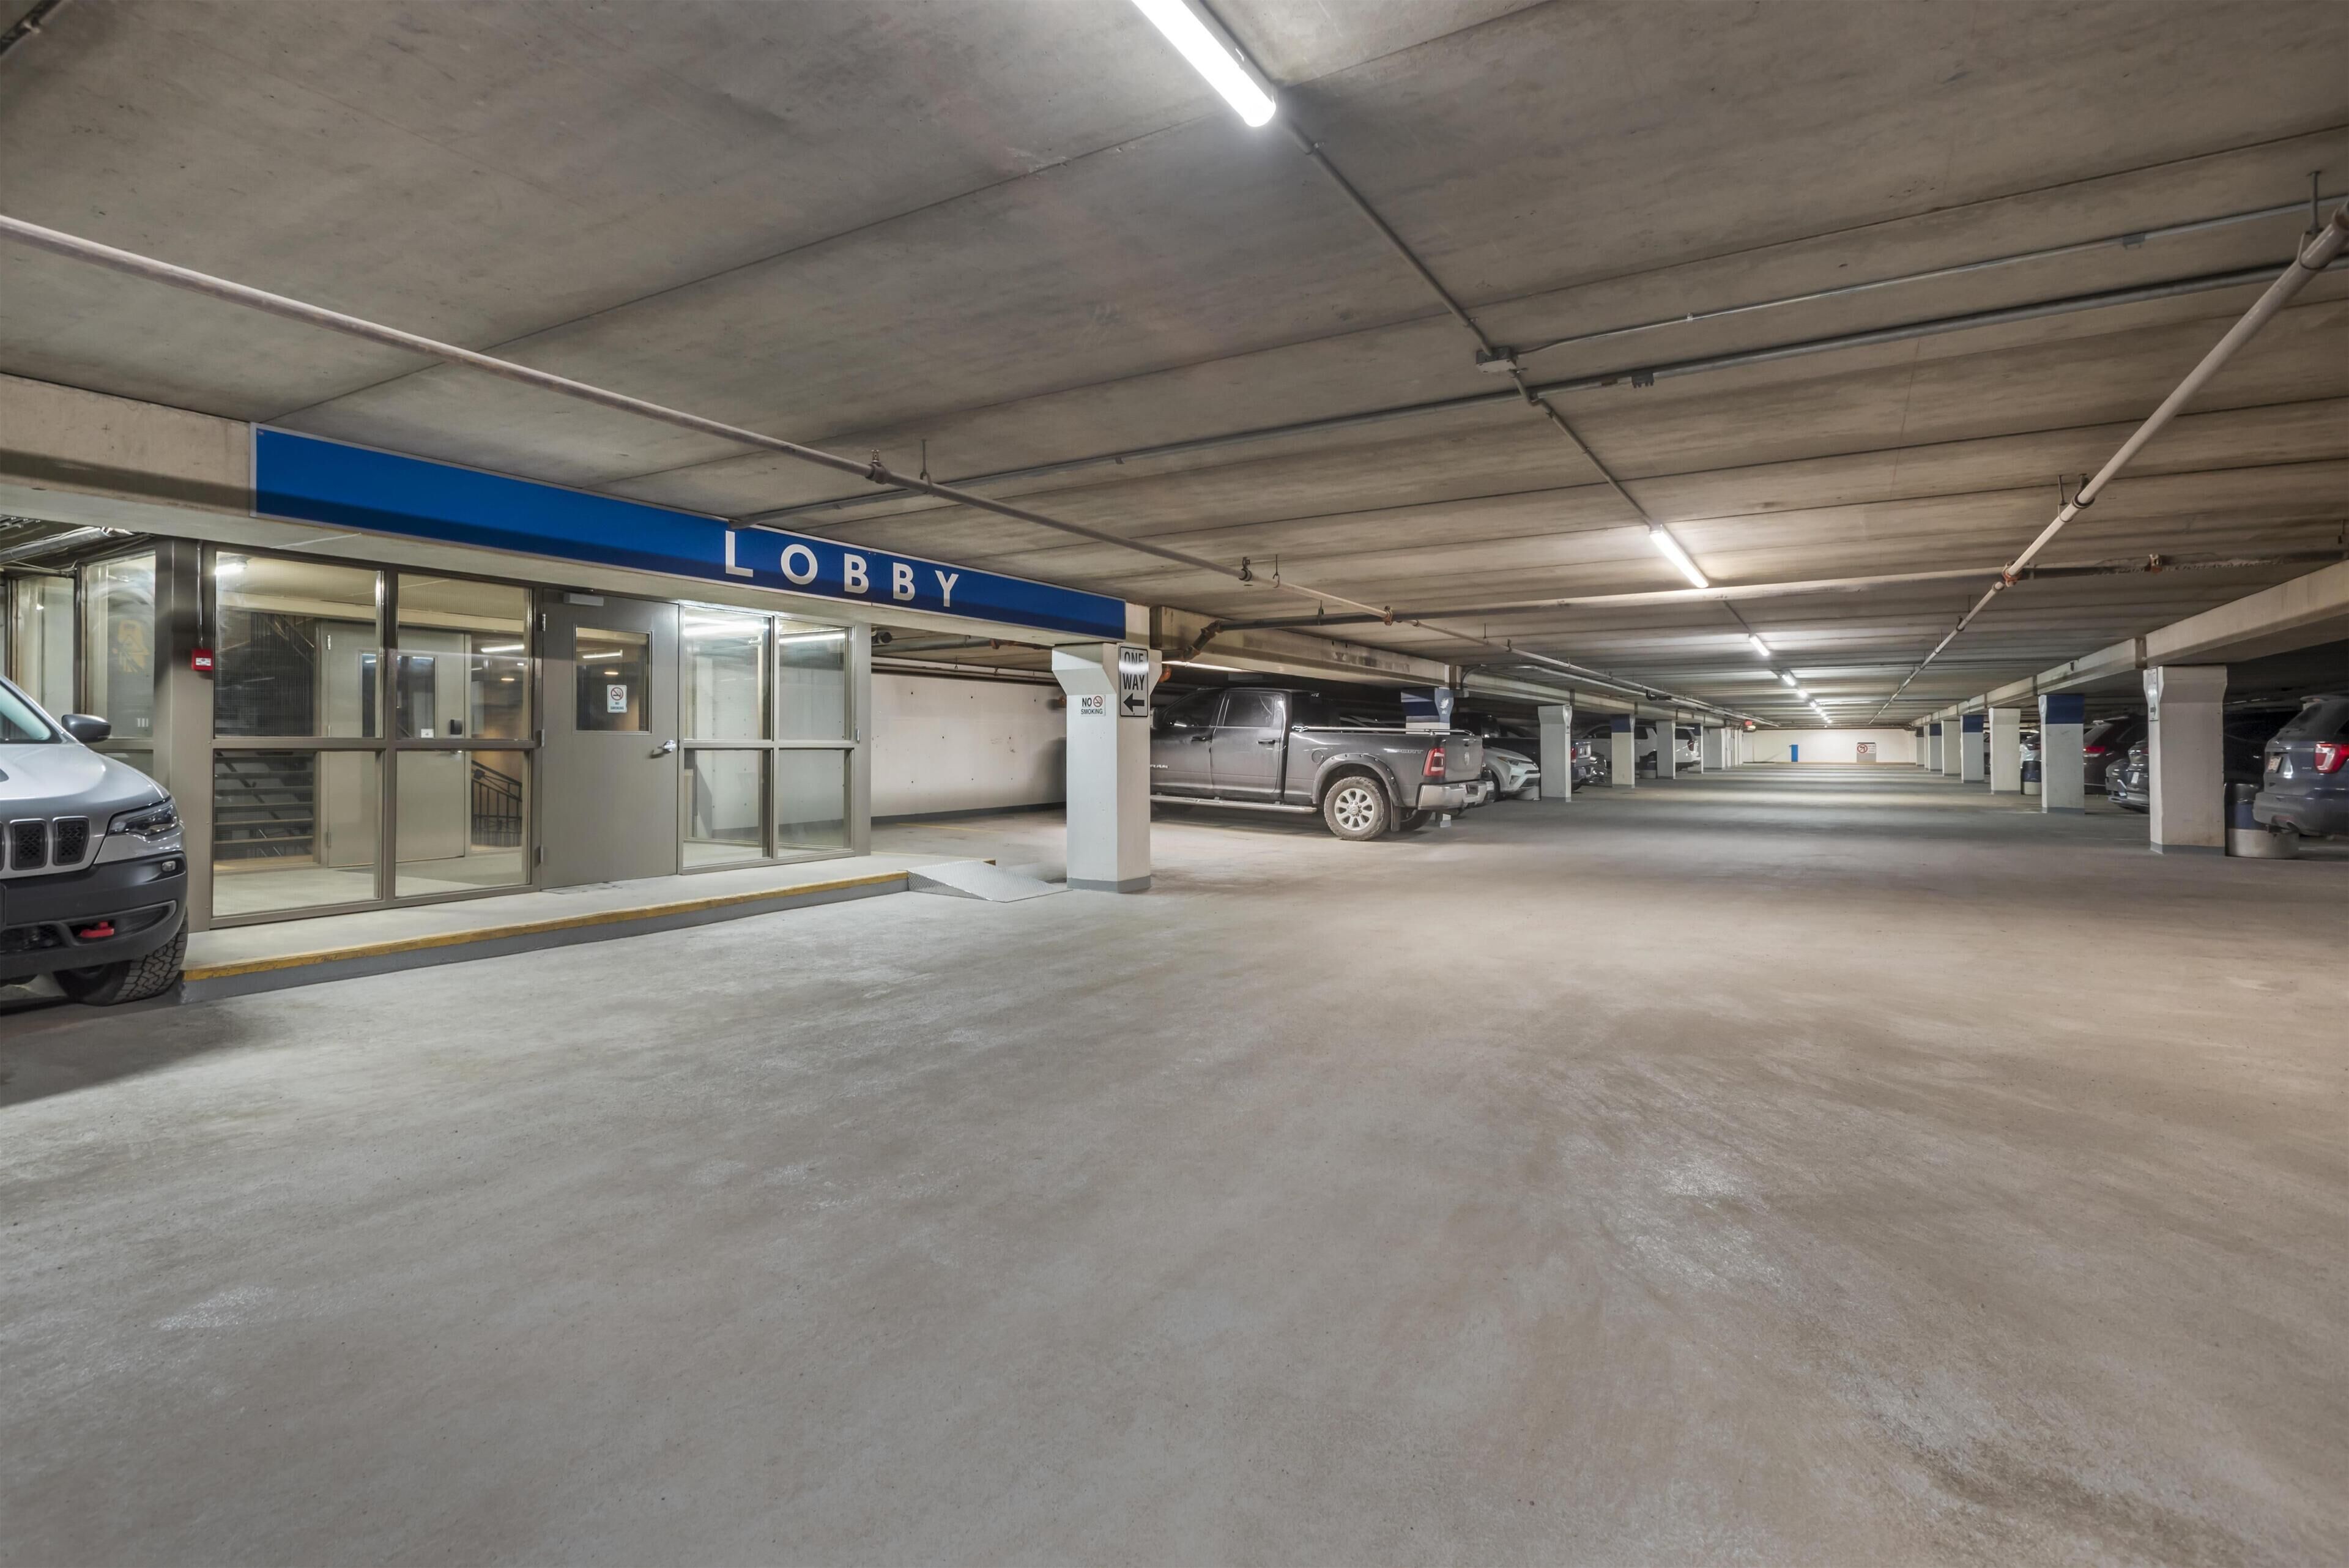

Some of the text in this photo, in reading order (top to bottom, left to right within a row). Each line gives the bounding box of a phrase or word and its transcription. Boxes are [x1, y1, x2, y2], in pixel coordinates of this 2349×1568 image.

[725, 530, 959, 608] LOBBY
[1124, 652, 1144, 664] ONE
[1123, 673, 1145, 691] WAY
[1082, 697, 1093, 707] NO
